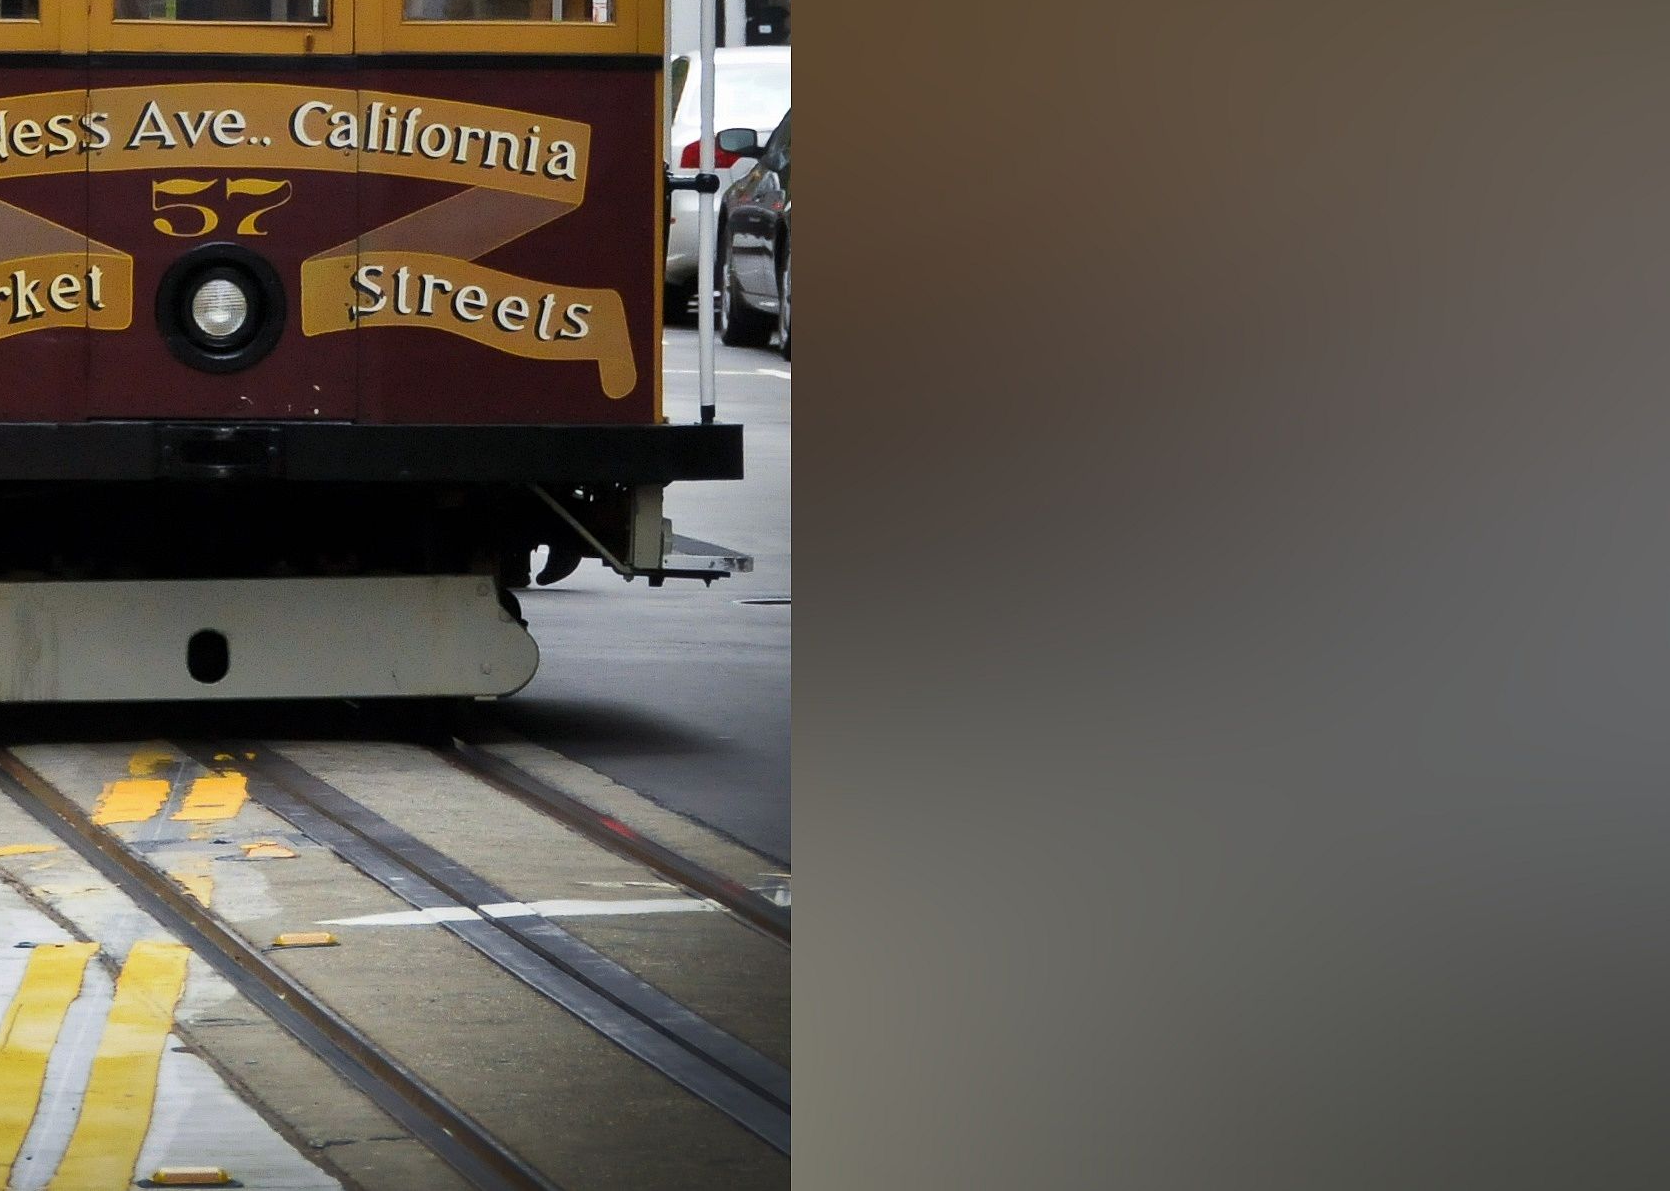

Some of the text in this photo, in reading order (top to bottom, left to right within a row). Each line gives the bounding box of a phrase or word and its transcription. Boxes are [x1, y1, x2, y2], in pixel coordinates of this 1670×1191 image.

[288, 100, 577, 181] California
[152, 177, 293, 237] 57
[348, 265, 593, 341] Streets
